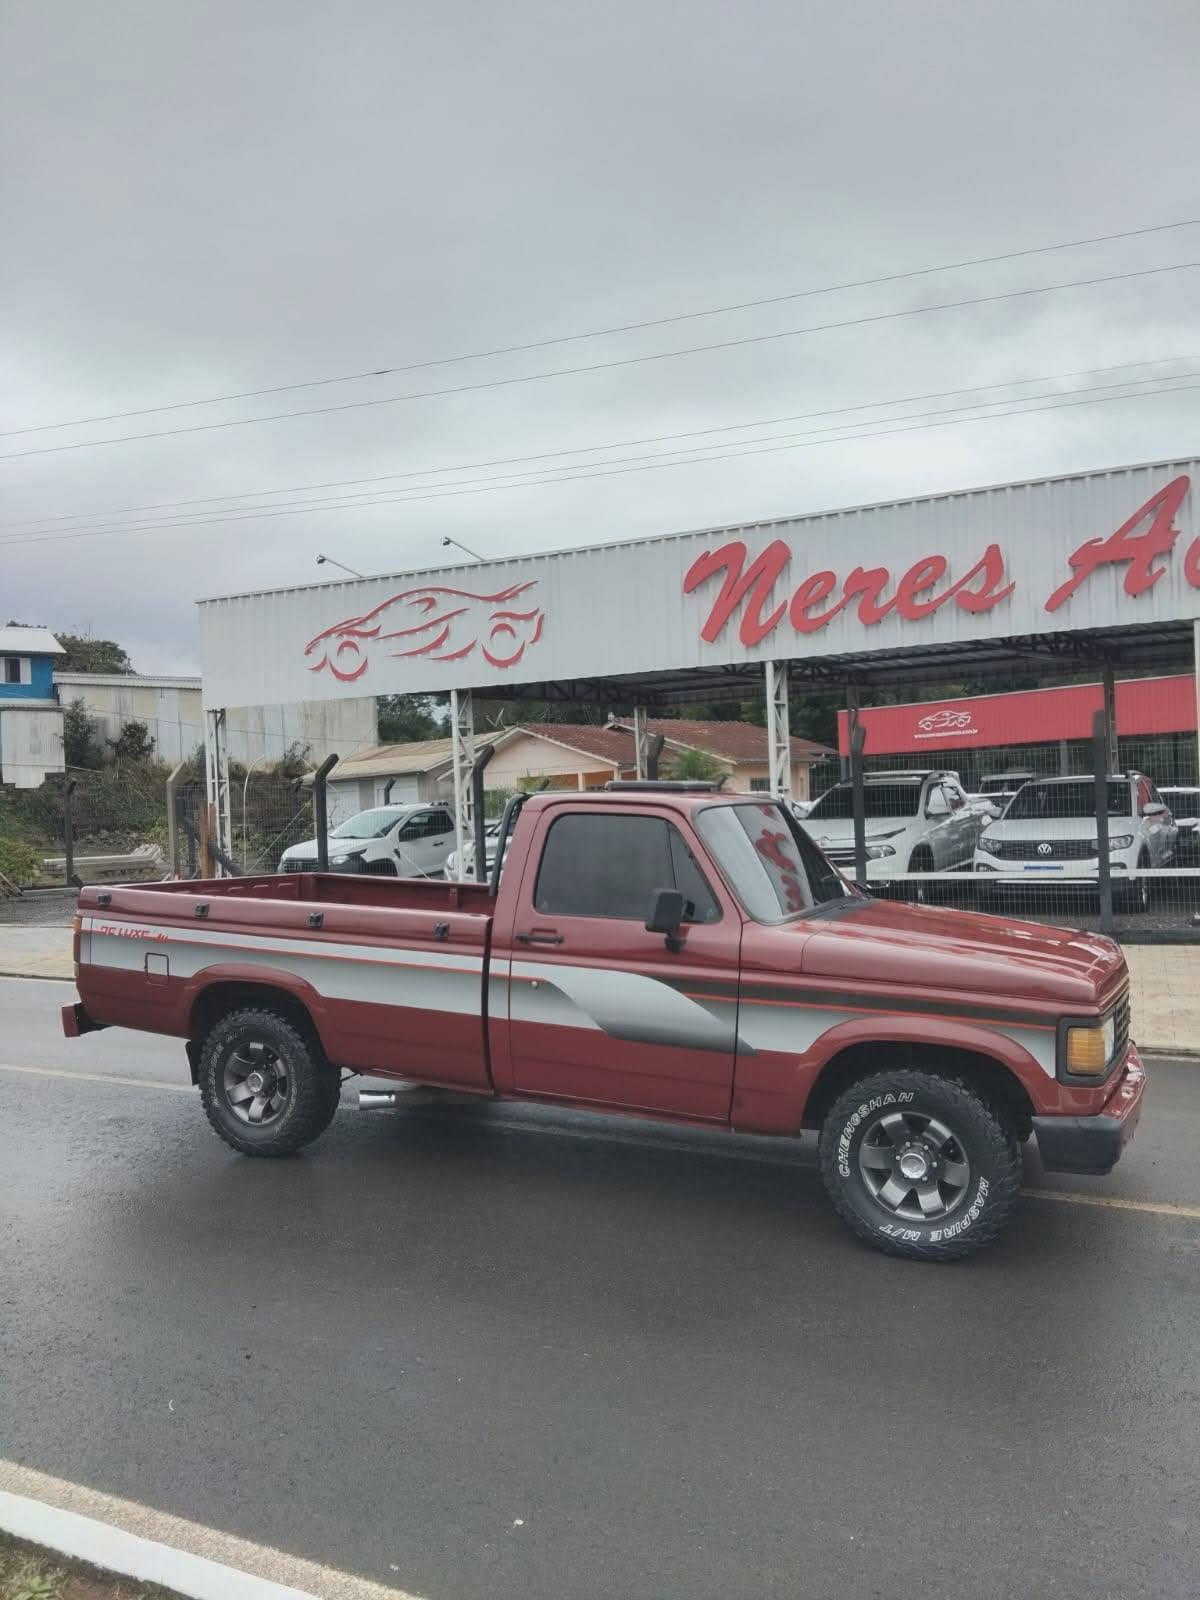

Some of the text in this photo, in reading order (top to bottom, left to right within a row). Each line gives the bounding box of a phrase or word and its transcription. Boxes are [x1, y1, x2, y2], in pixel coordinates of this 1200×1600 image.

[683, 539, 1016, 648] Neres
[118, 928, 150, 939] LUXE
[837, 1092, 915, 1177] CHENGSHAN
[879, 1223, 921, 1241] M/T
